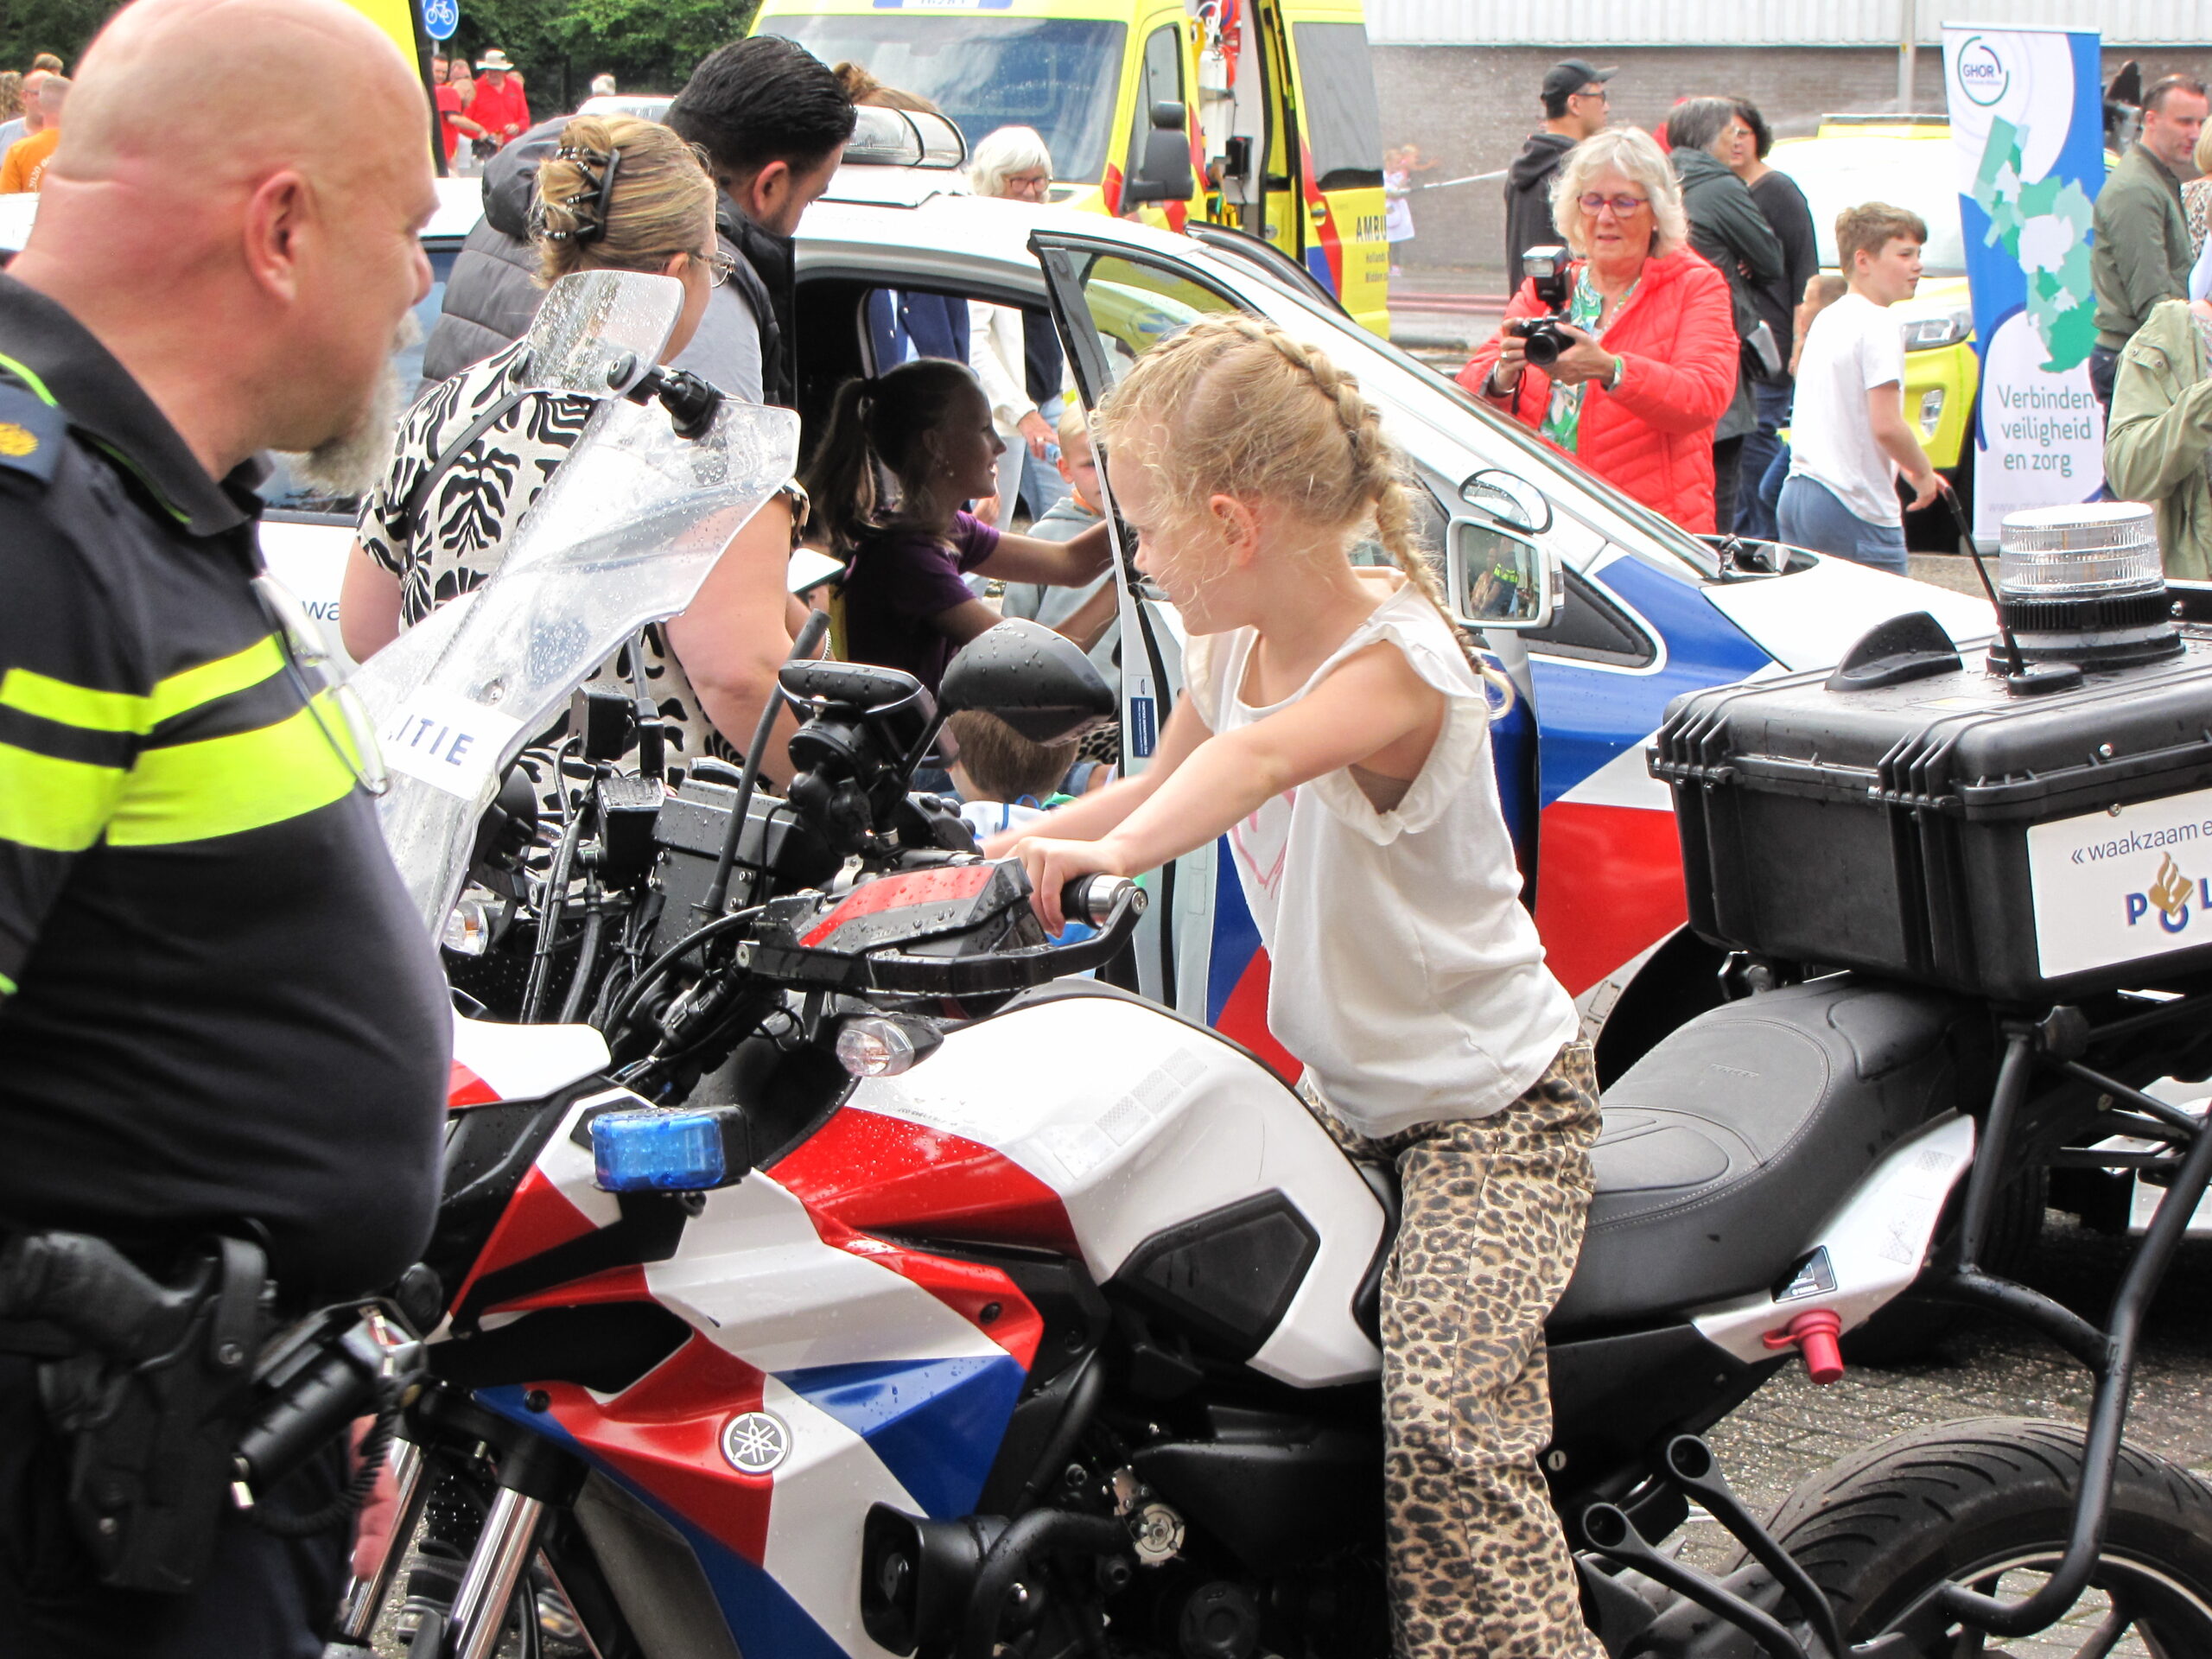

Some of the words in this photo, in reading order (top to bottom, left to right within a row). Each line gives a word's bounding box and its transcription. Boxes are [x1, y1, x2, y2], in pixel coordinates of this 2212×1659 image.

[1962, 64, 1994, 78] GHOR
[1998, 385, 2095, 410] Verbinden
[2001, 416, 2092, 447] veiligheid
[2004, 453, 2027, 471] en
[2031, 454, 2073, 478] zorg
[2088, 823, 2197, 861] waakzaam
